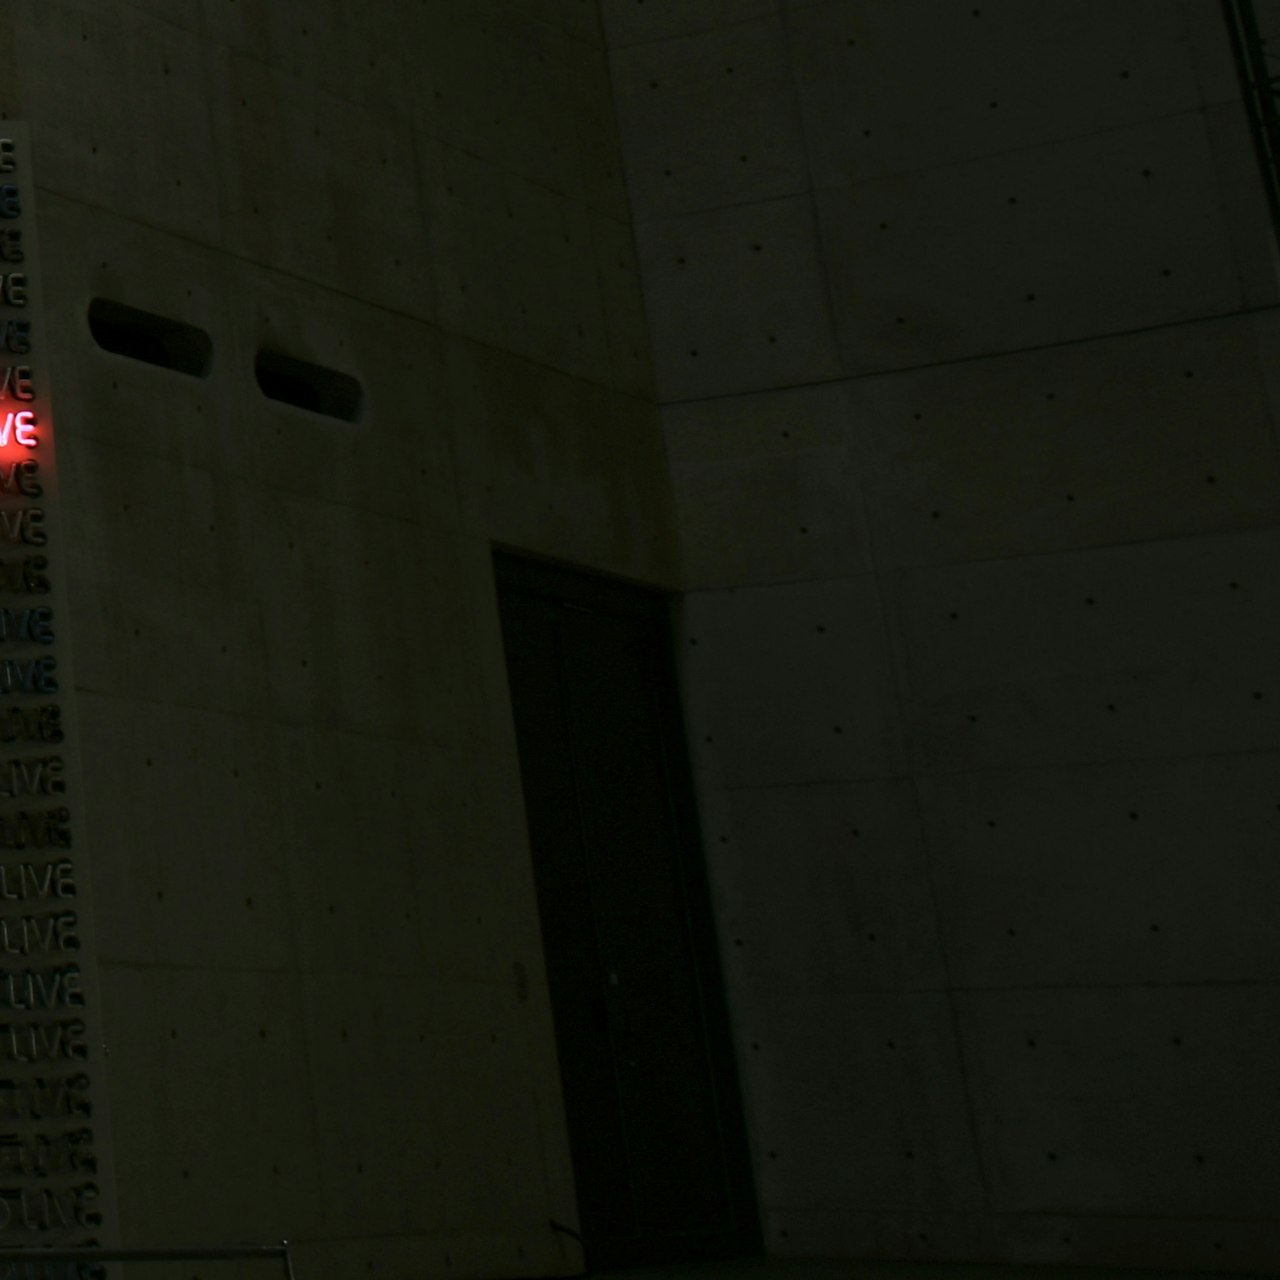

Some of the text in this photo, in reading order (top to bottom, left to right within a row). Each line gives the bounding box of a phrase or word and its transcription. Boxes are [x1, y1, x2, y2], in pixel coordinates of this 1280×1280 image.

[0, 861, 75, 898] LIVE
[3, 918, 80, 954] LIVE
[7, 972, 83, 1010] LIVE
[9, 1026, 86, 1062] LIVE
